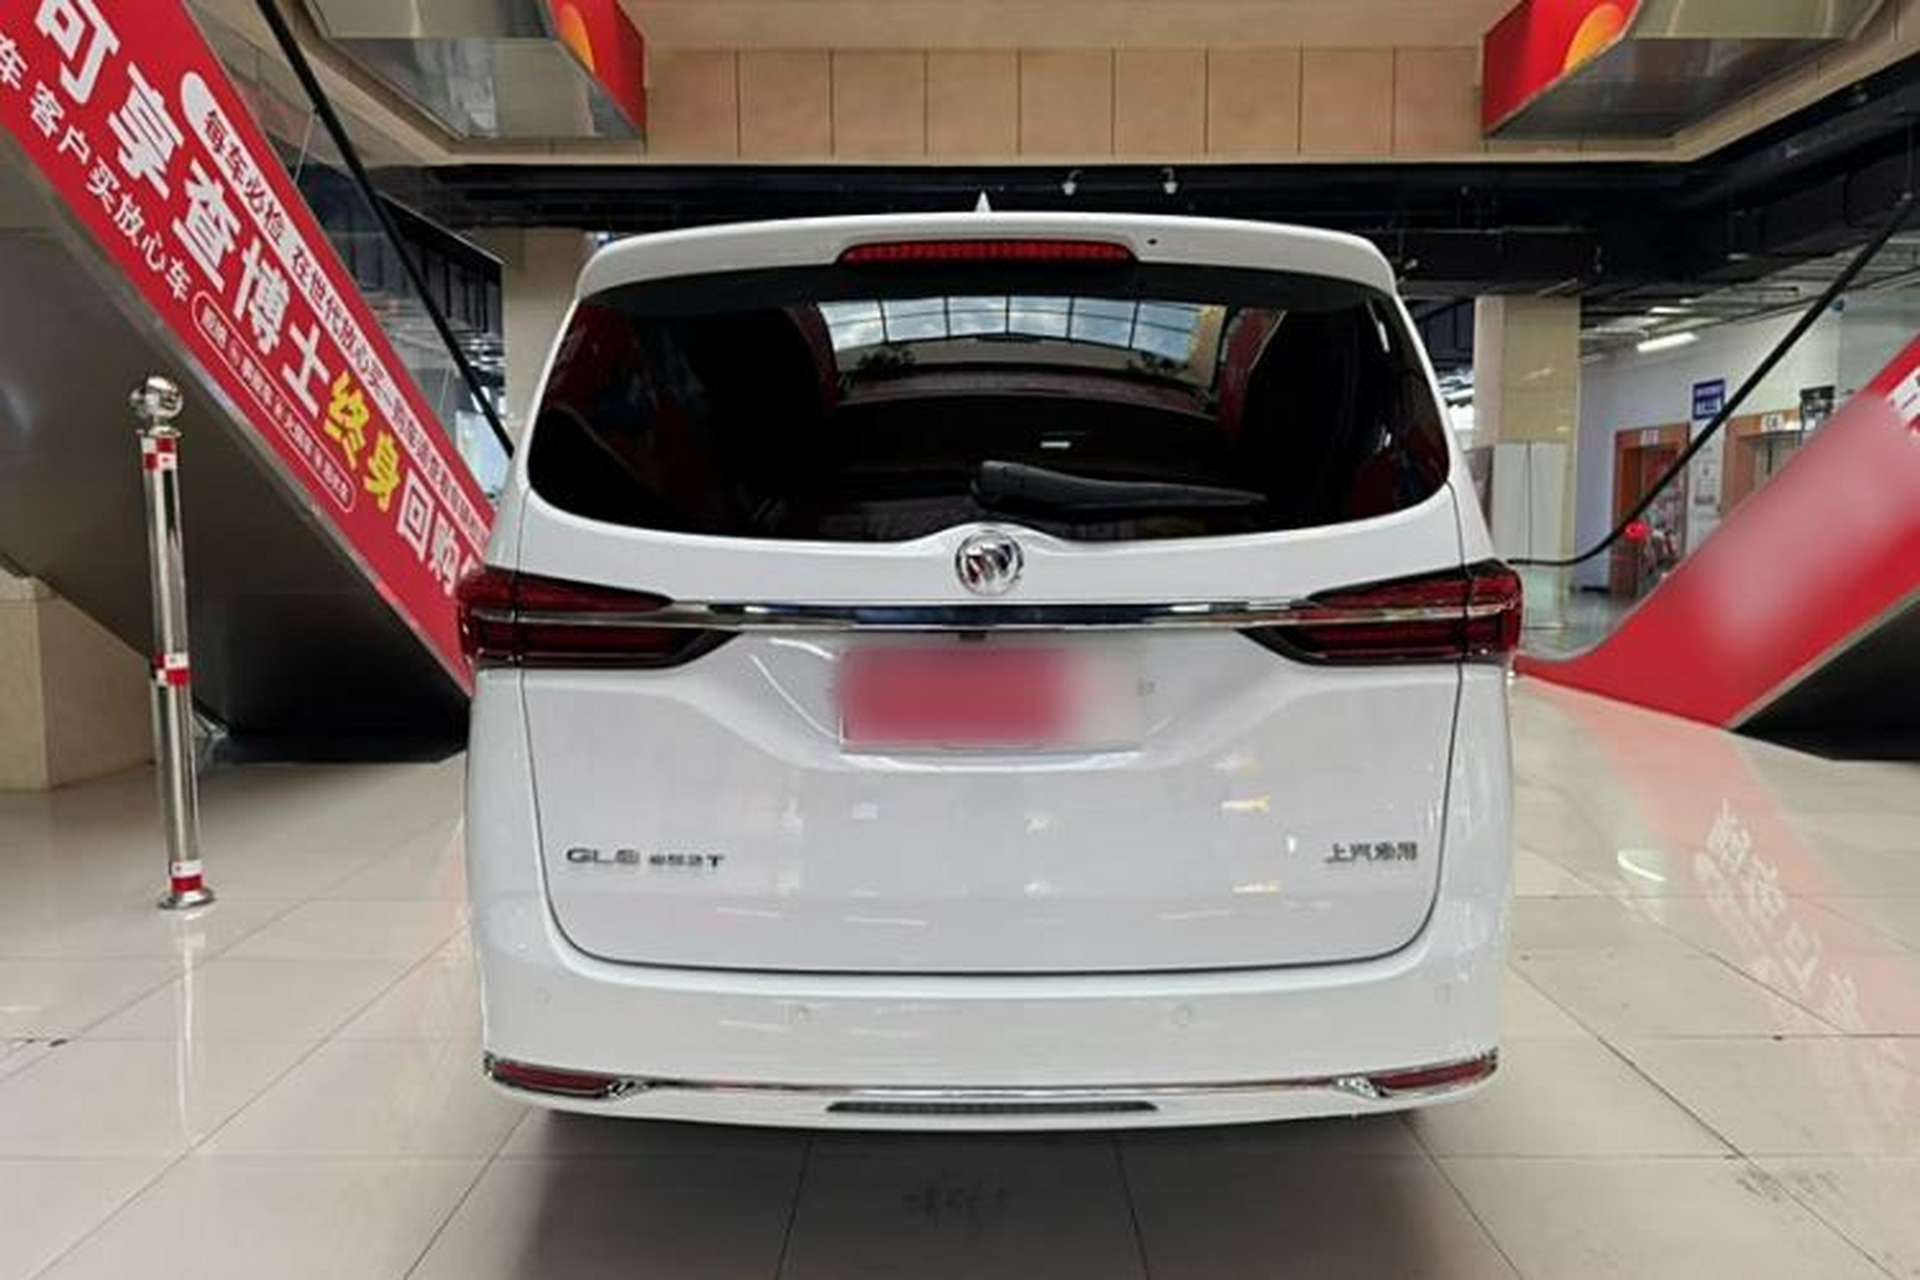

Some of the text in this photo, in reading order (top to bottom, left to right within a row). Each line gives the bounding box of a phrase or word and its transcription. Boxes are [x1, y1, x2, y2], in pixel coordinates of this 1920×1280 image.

[34, 0, 480, 596] 可享查博士终身回购
